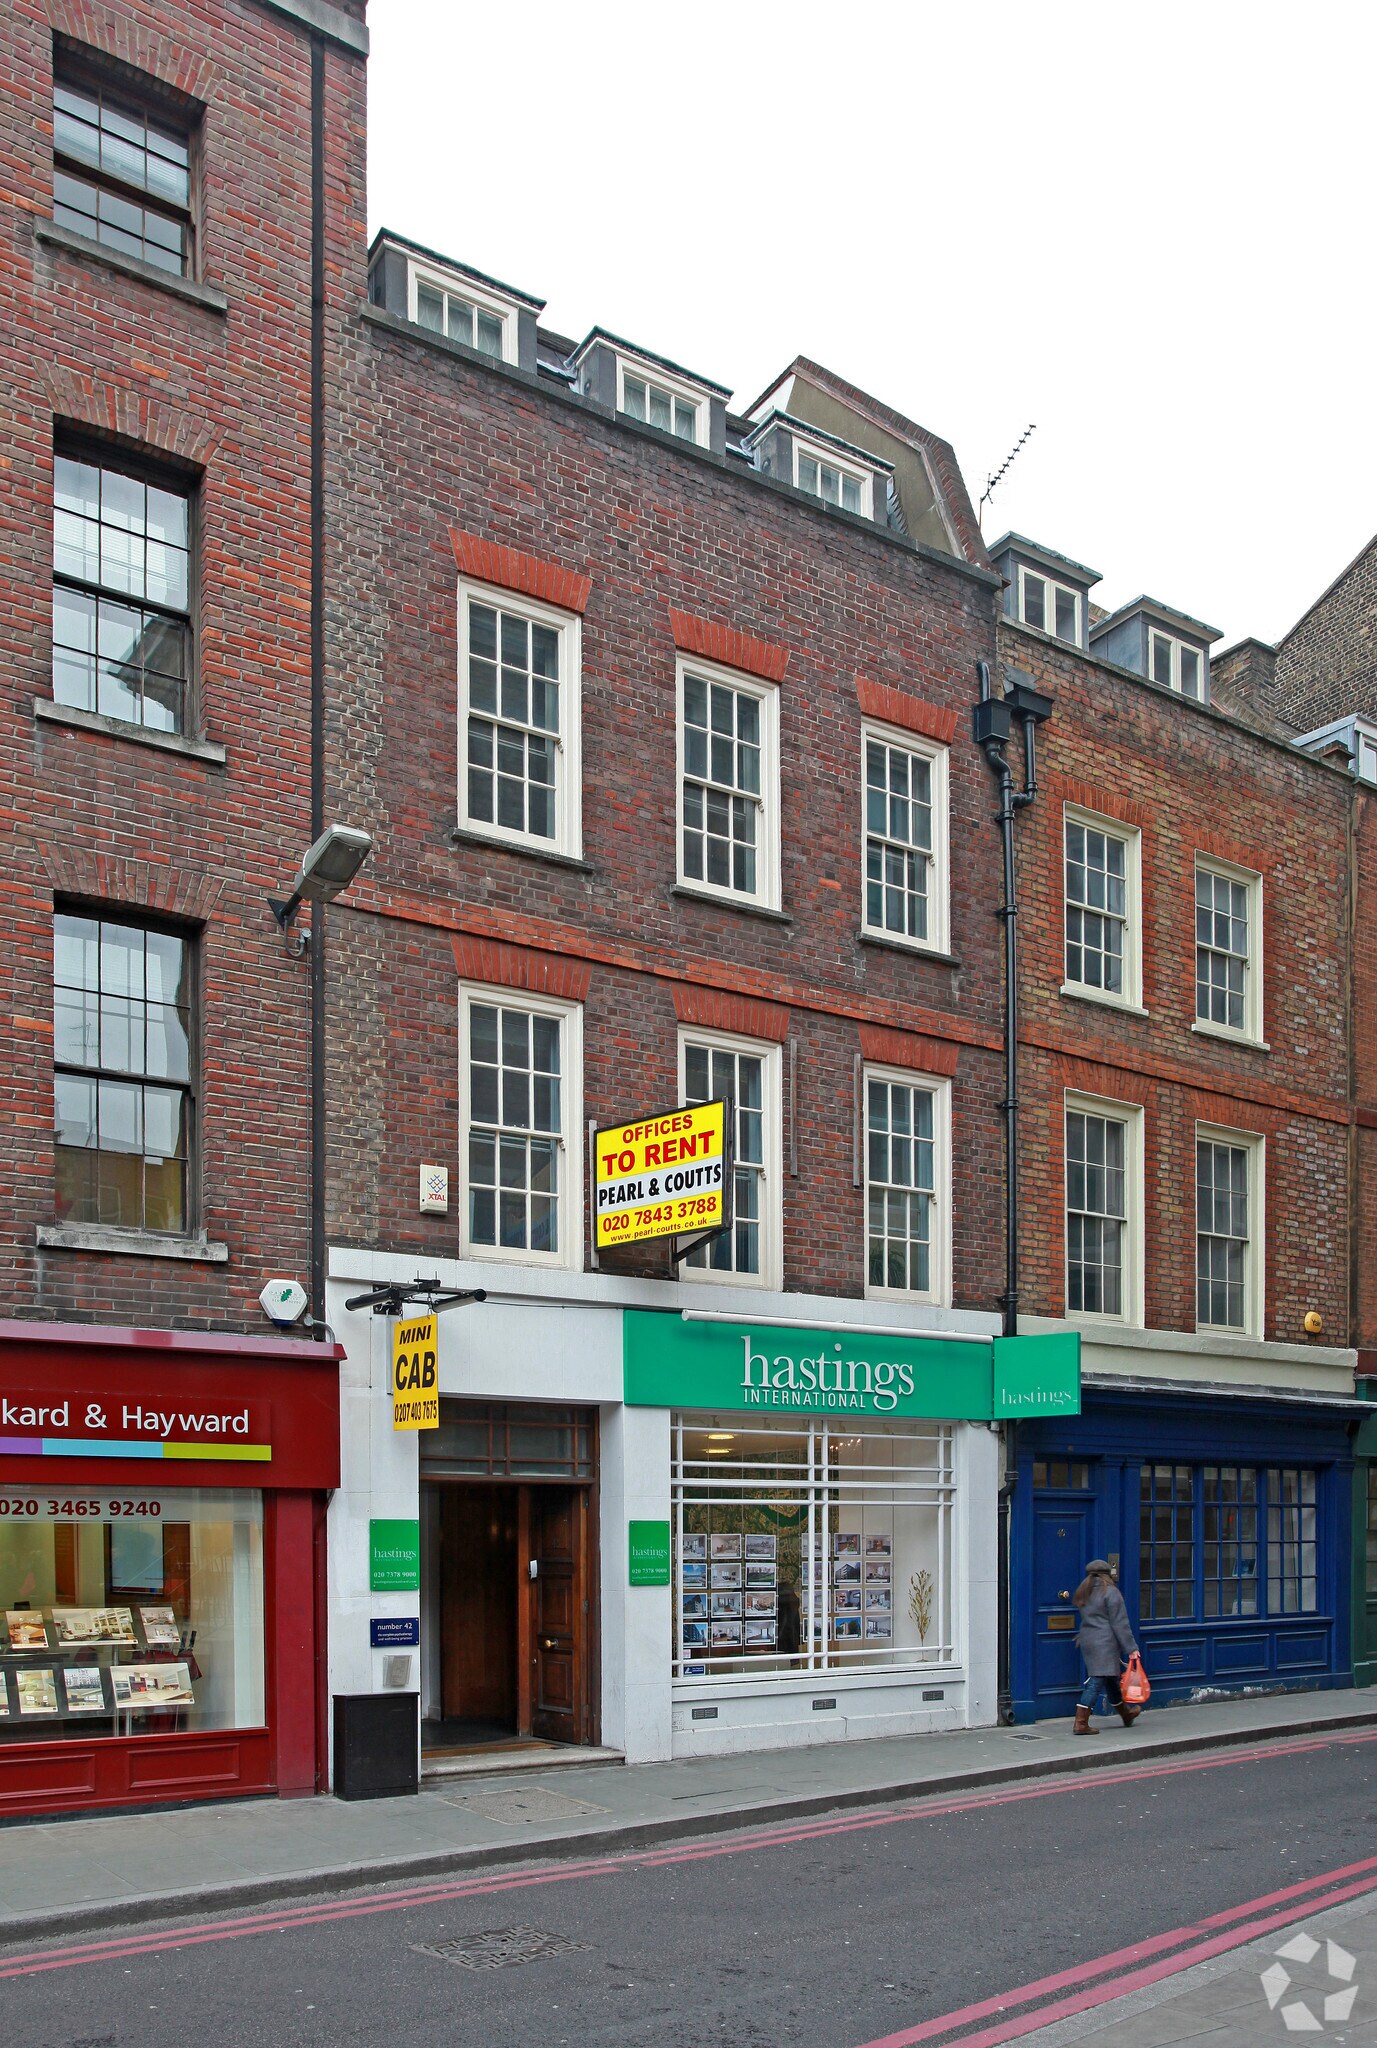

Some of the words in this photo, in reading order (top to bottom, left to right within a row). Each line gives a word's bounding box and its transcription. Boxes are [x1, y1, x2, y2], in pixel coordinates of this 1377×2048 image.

[622, 1114, 693, 1144] OFFICES
[602, 1150, 635, 1176] TO
[645, 1130, 715, 1167] RENT
[599, 1181, 644, 1207] PEARL
[648, 1178, 660, 1197] &
[665, 1163, 721, 1193] COUTTS
[428, 1193, 446, 1201] XTAL
[603, 1214, 629, 1232] 020
[634, 1205, 673, 1226] 7843
[677, 1196, 717, 1218] 3788
[399, 1325, 431, 1345] MINI
[395, 1351, 436, 1391] CAB
[741, 1335, 915, 1411] hastings
[744, 1389, 866, 1408] INTERNATIONAL
[1002, 1387, 1071, 1406] hastings
[2, 1399, 69, 1427] kard
[84, 1403, 107, 1428] &
[122, 1405, 249, 1437] Hayward
[395, 1403, 410, 1422] 0207
[411, 1402, 421, 1420] 403
[422, 1400, 437, 1420] 7675
[0, 1499, 39, 1516] 020
[47, 1500, 101, 1516] 3465
[109, 1501, 161, 1516] 9240
[374, 1547, 417, 1561] hastings
[632, 1546, 667, 1558] hastings
[377, 1623, 403, 1631] number
[404, 1622, 413, 1630] 42
